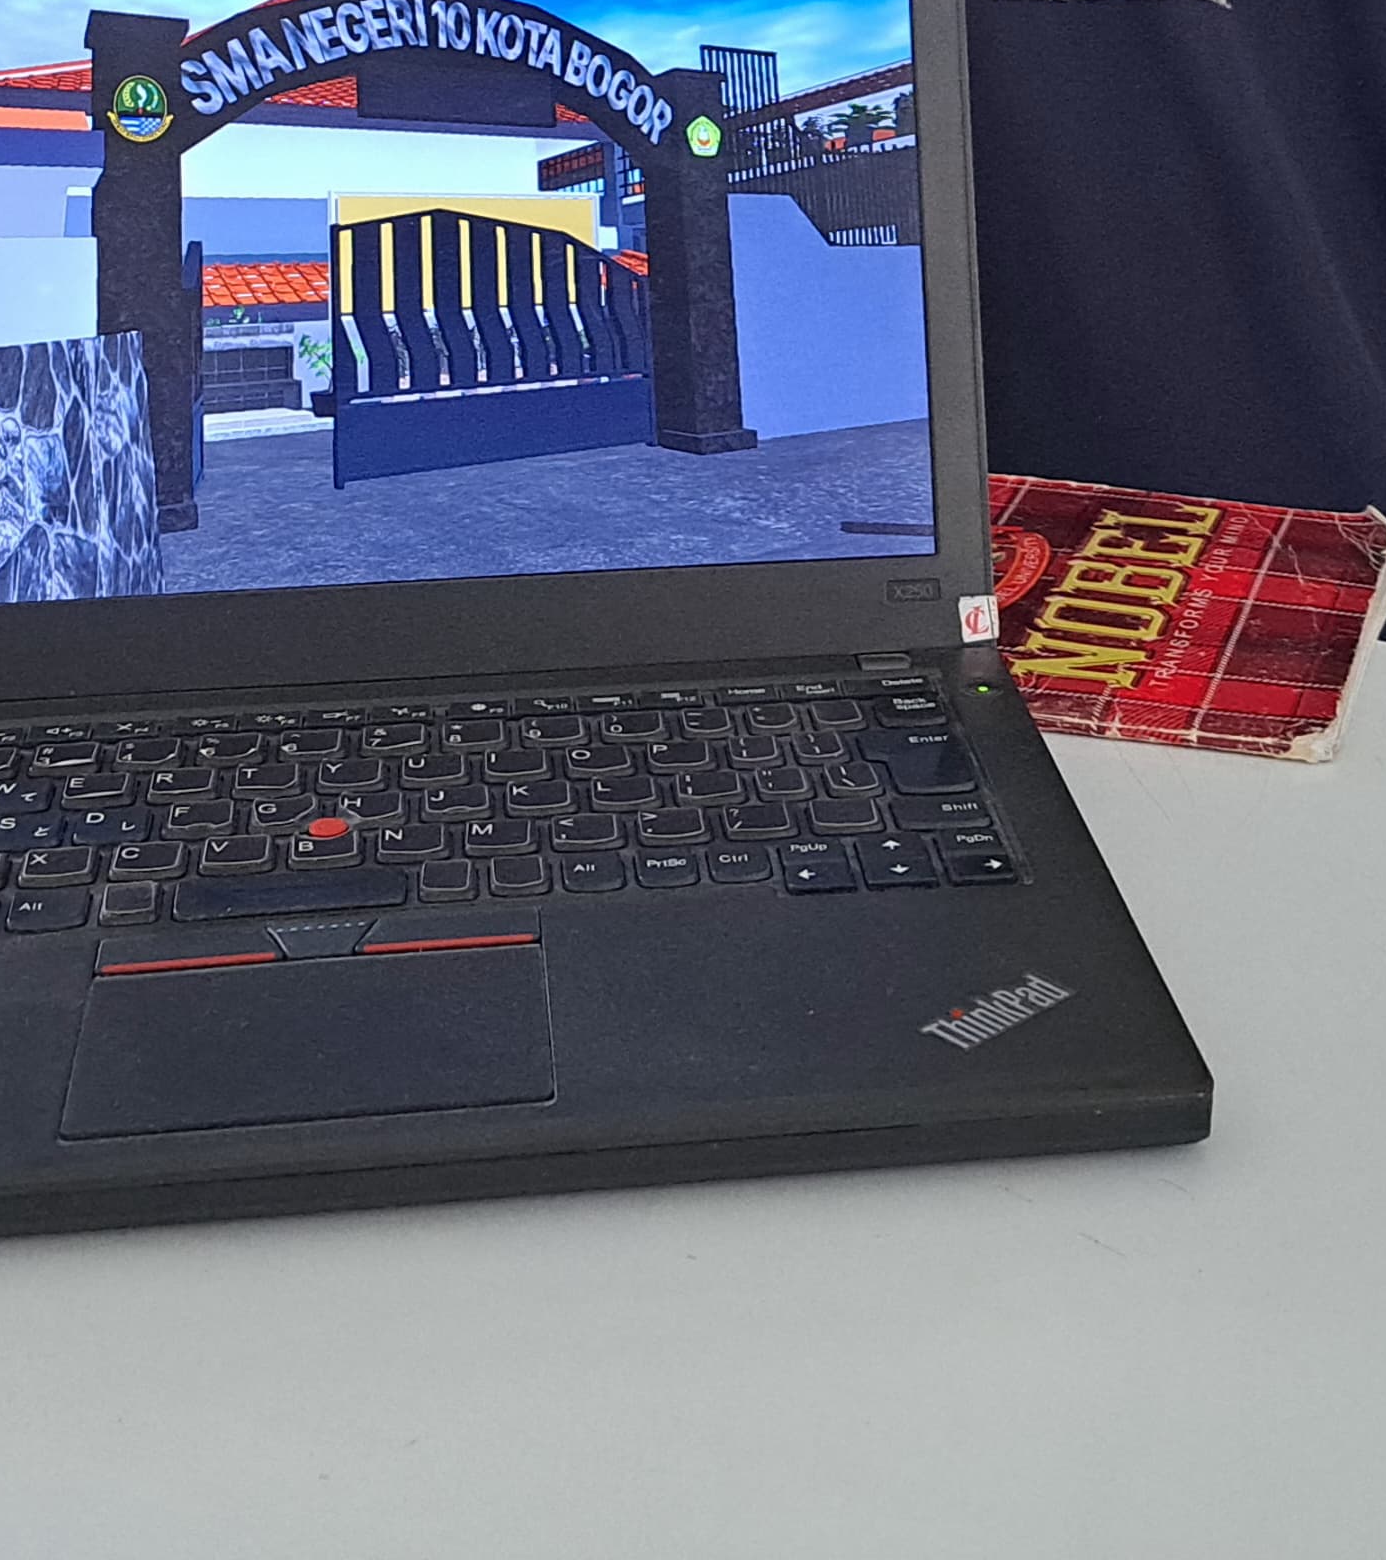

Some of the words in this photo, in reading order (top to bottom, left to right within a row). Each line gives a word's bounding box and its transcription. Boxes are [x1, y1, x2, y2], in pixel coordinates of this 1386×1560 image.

[180, 27, 296, 115] SMA
[431, 0, 471, 50] 10
[475, 7, 562, 76] KOTA
[564, 40, 673, 145] BOGOR
[1010, 501, 1224, 690] NOBEL
[1148, 588, 1214, 691] TRANSFORMS
[908, 733, 950, 744] Enter
[571, 749, 591, 760] O
[652, 743, 668, 754] P
[325, 762, 343, 774] Y
[408, 757, 426, 769] U
[155, 772, 174, 784] R
[241, 767, 259, 779] T
[69, 777, 86, 789] E
[596, 780, 612, 792] L
[430, 790, 445, 802] J
[512, 785, 530, 796] K
[257, 802, 277, 815] G
[343, 797, 361, 808] H
[941, 801, 979, 812] Shift
[174, 805, 191, 818] F
[85, 812, 105, 825] D
[384, 829, 403, 841] N
[471, 823, 494, 836] M
[956, 834, 995, 844] PgDn
[210, 841, 229, 852] V
[298, 841, 314, 852] B
[790, 842, 828, 854] PgUp
[120, 847, 141, 859] C
[718, 852, 749, 864] Ctrl
[29, 853, 49, 866] X
[646, 856, 687, 868] PrtSc
[572, 862, 596, 873] Alt
[18, 901, 44, 912] Alt
[921, 972, 1071, 1050] ThinkPad
